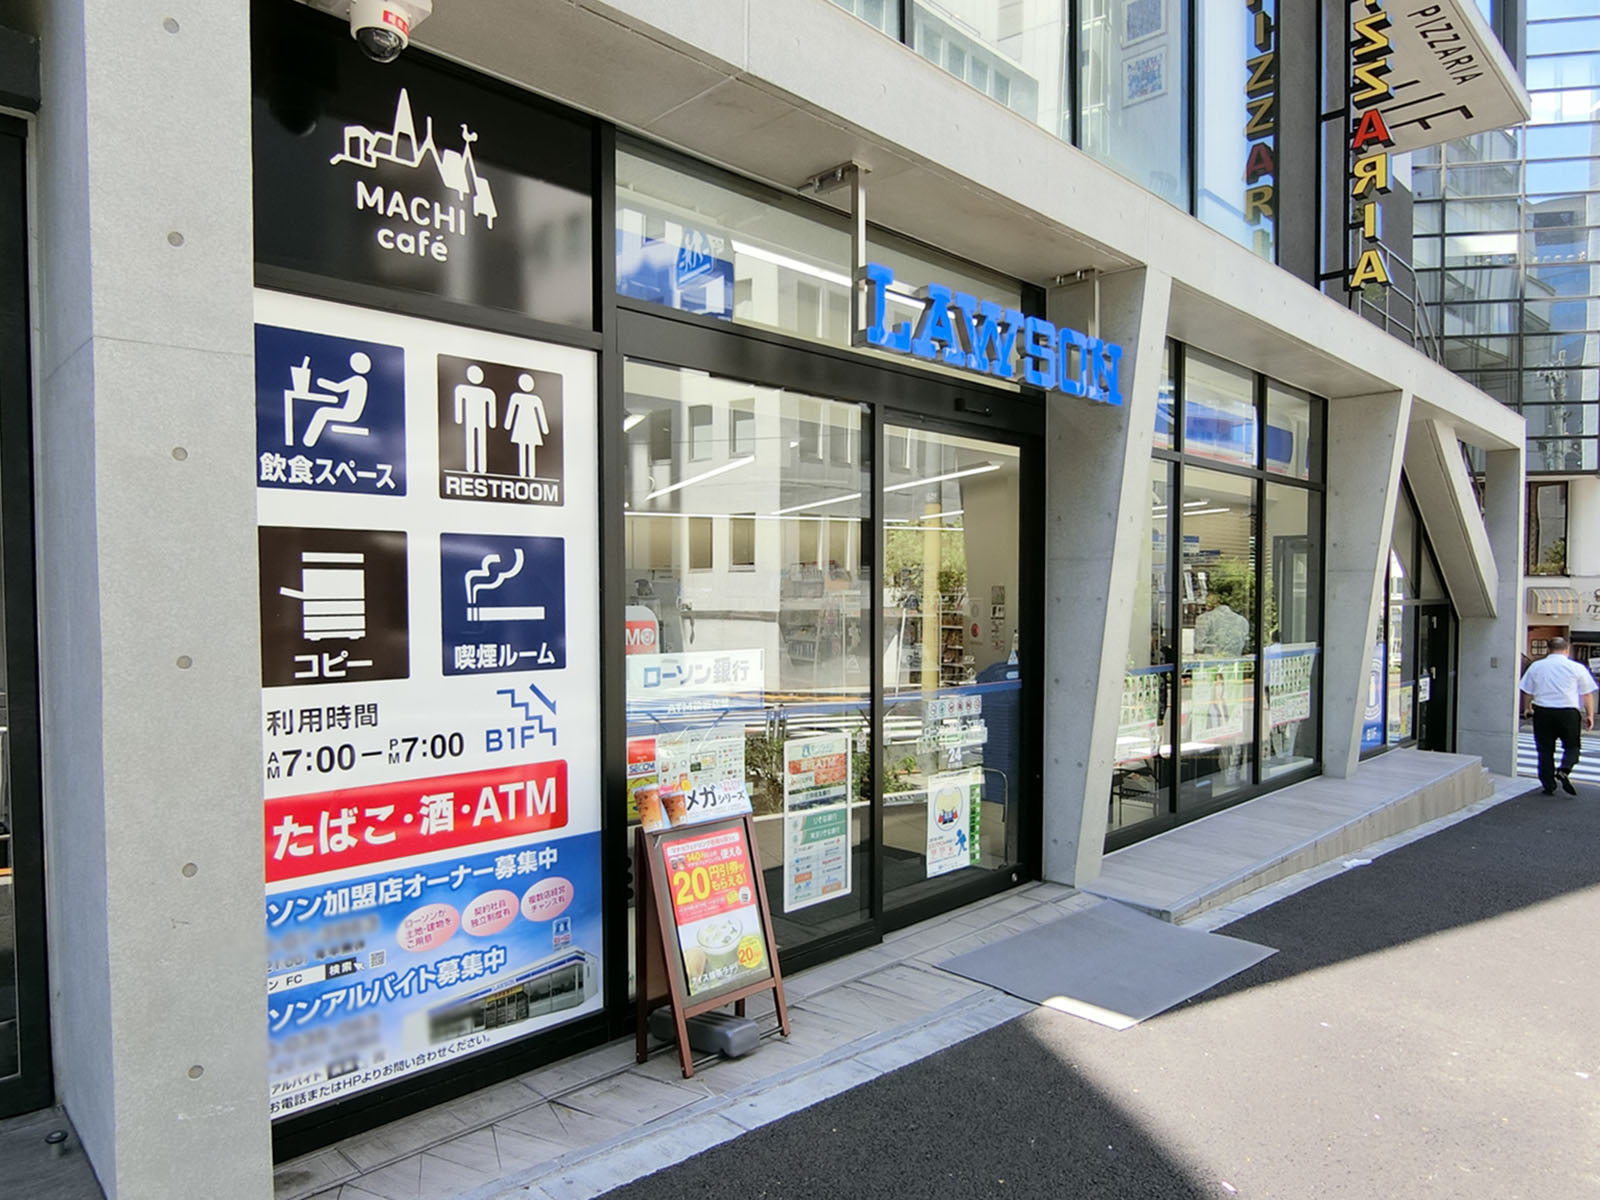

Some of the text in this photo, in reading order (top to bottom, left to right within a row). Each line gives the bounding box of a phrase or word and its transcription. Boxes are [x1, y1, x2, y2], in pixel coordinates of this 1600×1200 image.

[1407, 4, 1484, 86] PIZZARIA
[357, 180, 466, 236] MACHI
[377, 228, 448, 261] café
[866, 261, 1123, 406] LAWSON
[260, 453, 396, 489] 飲食スペース
[446, 476, 559, 503] RESTROOM
[295, 650, 373, 679] コピー
[454, 642, 556, 670] 喫煙ルーム
[266, 703, 379, 737] 利用時間
[485, 726, 535, 753] B1F
[272, 776, 557, 861] たばこ・酒・ATM
[266, 846, 558, 927] ソン加盟店オーナー募集中
[672, 866, 711, 906] 20
[269, 946, 507, 1033] ソンアルバイト募集中
[286, 974, 302, 986] FC
